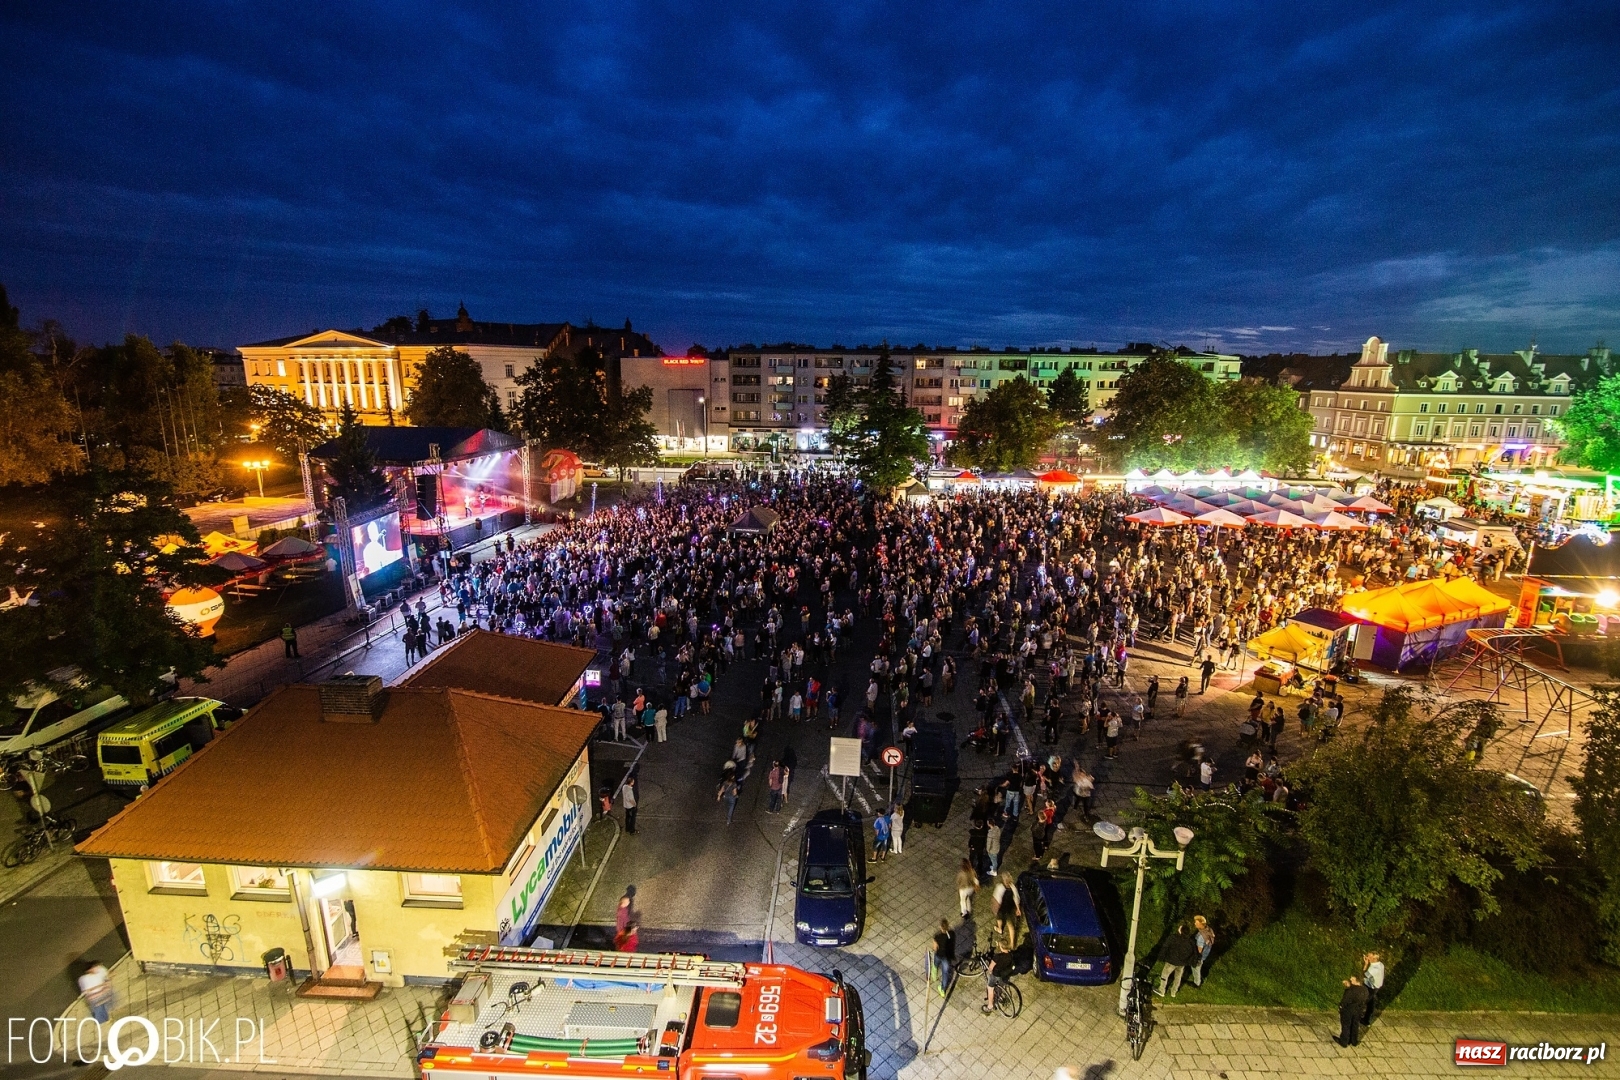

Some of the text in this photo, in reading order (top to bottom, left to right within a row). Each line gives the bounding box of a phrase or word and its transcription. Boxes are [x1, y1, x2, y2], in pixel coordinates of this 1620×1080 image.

[512, 803, 582, 924] Lycamobil
[758, 986, 780, 1012] 569
[754, 1023, 778, 1044] 32
